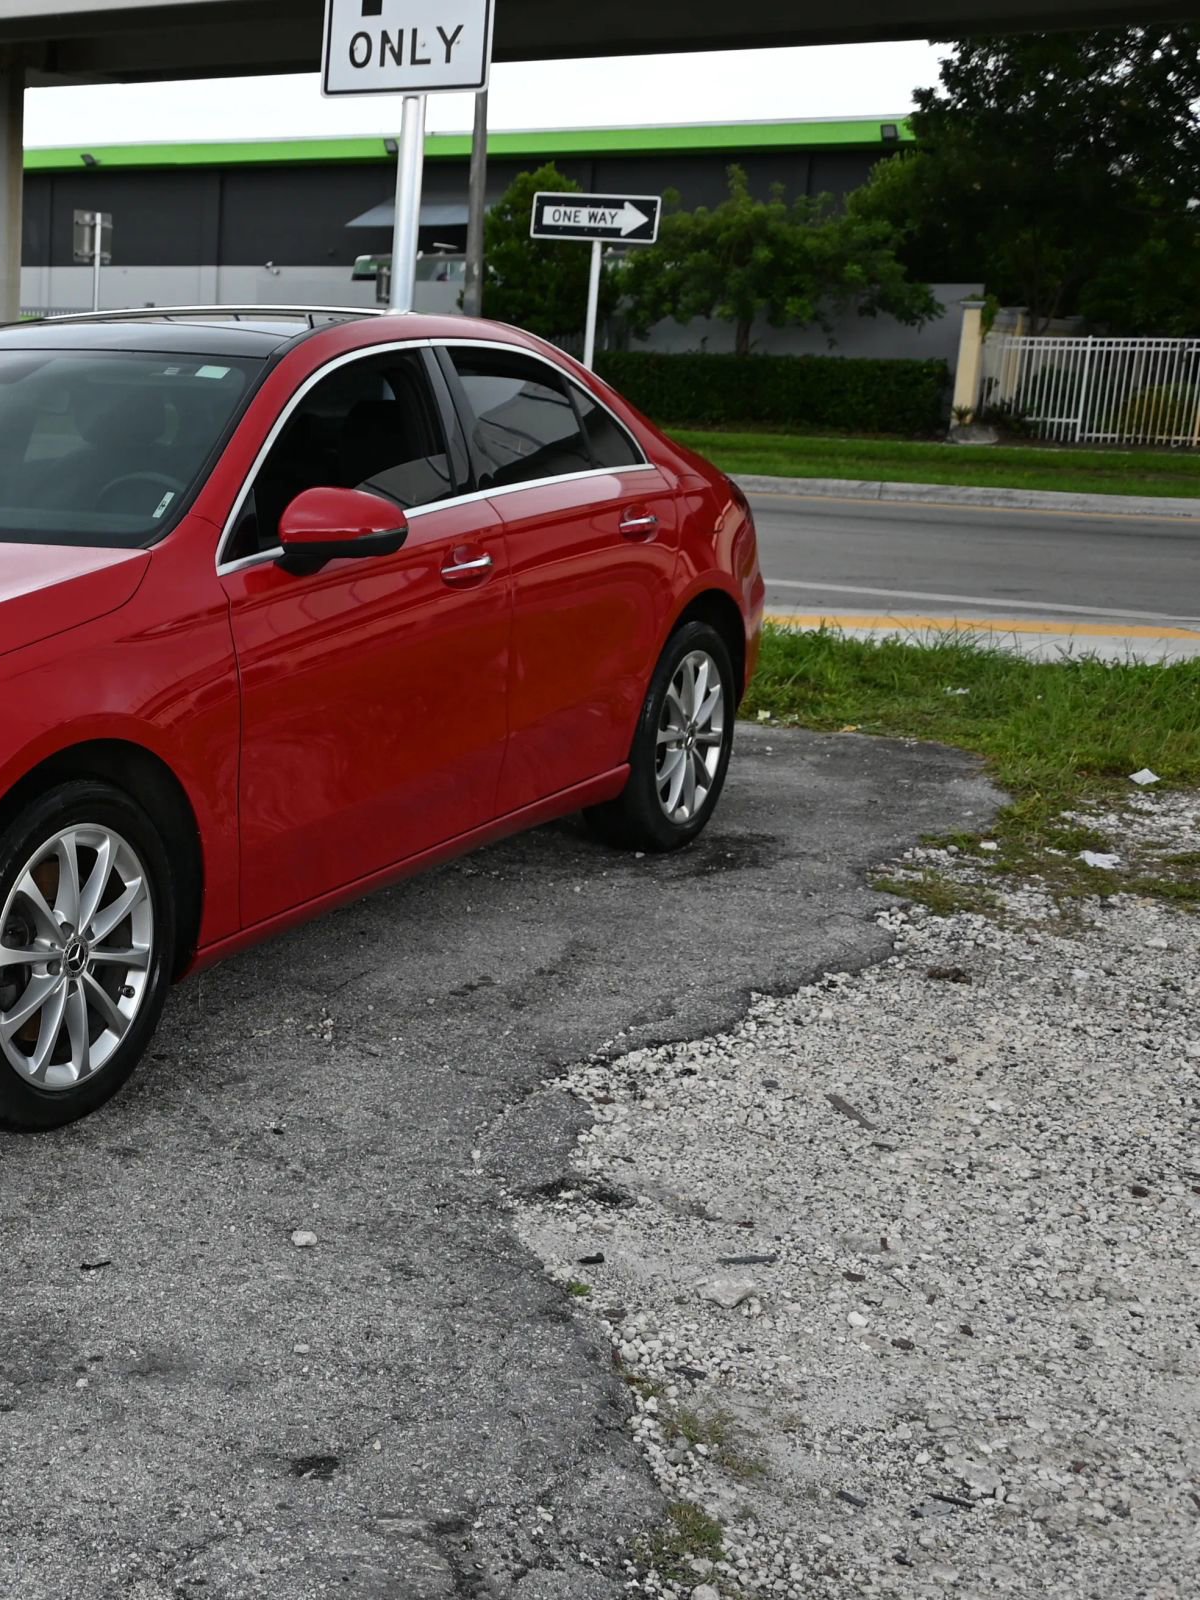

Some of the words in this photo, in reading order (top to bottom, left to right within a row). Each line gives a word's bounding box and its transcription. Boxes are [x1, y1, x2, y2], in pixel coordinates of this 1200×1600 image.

[349, 24, 464, 69] ONLY
[552, 208, 582, 223] ONE
[588, 210, 618, 225] WAY
